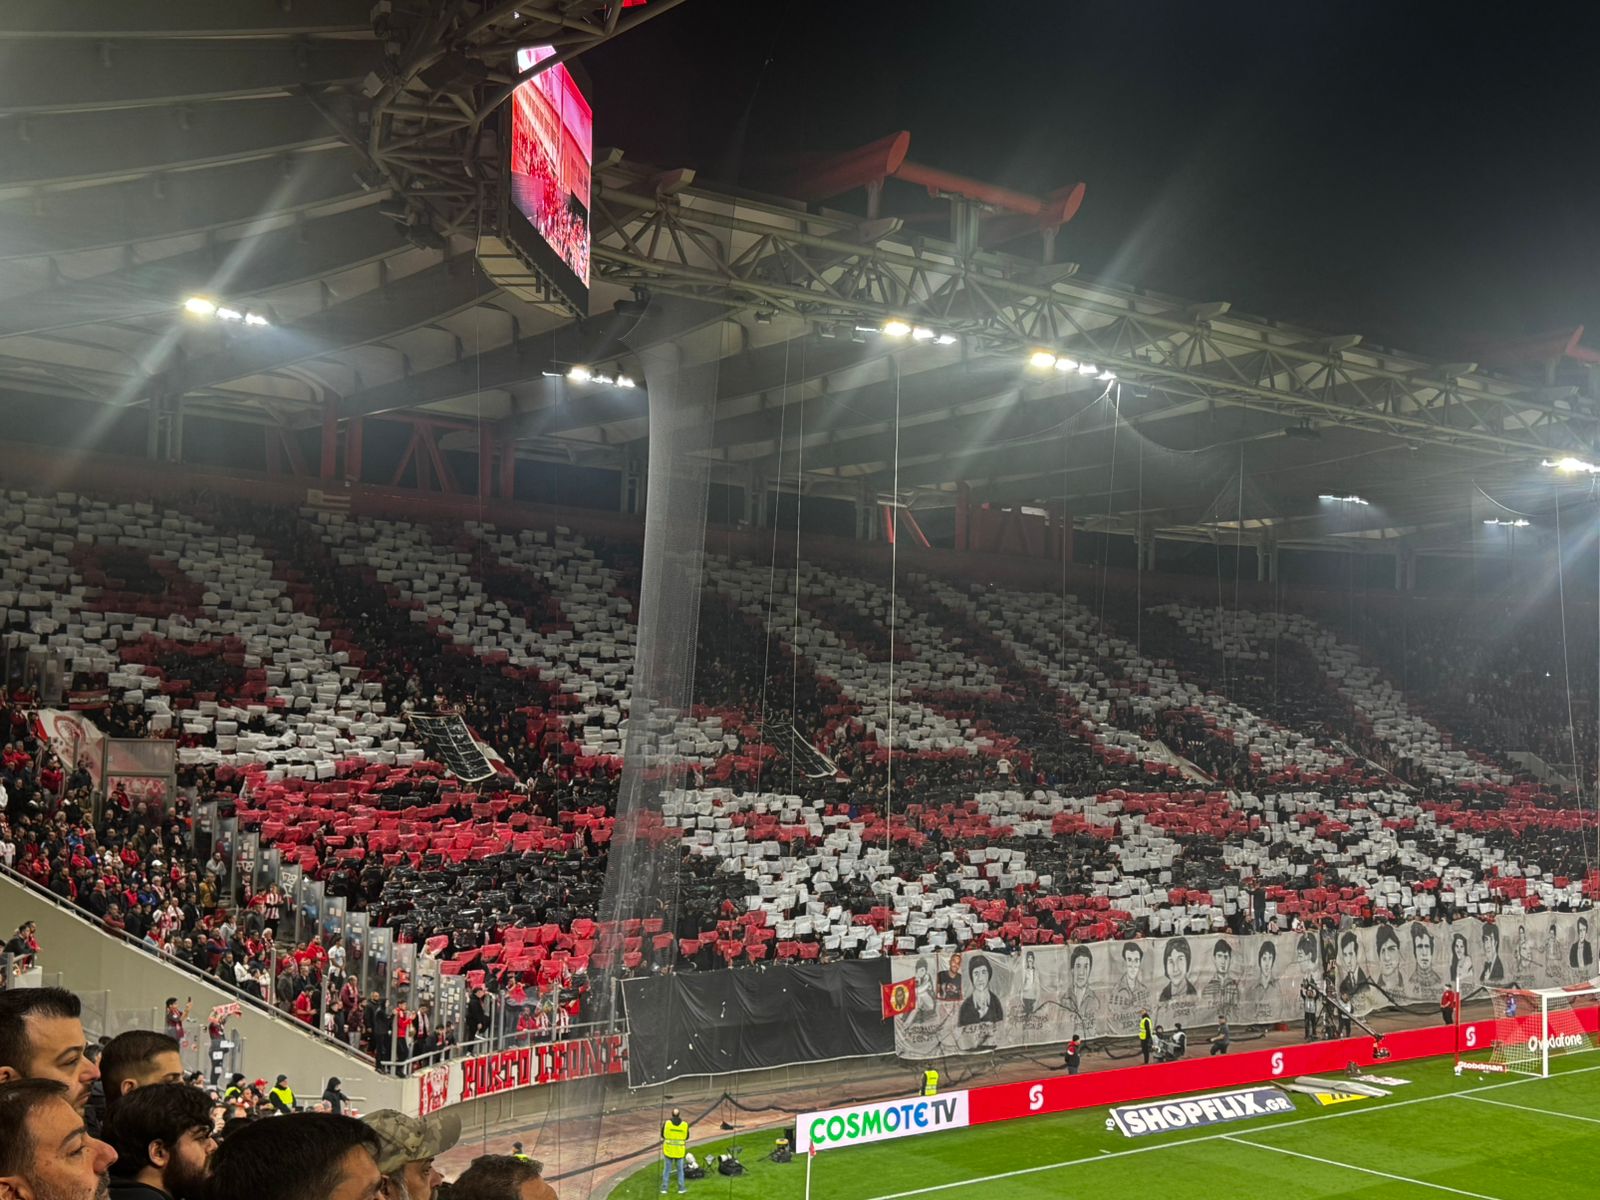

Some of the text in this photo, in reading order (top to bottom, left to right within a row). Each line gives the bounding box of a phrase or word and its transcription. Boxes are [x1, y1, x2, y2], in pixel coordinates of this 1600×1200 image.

[462, 1047, 532, 1102] PORTO
[809, 1097, 957, 1144] COSMOTE TV
[1123, 1092, 1293, 1134] SHOPFLIX.GR
